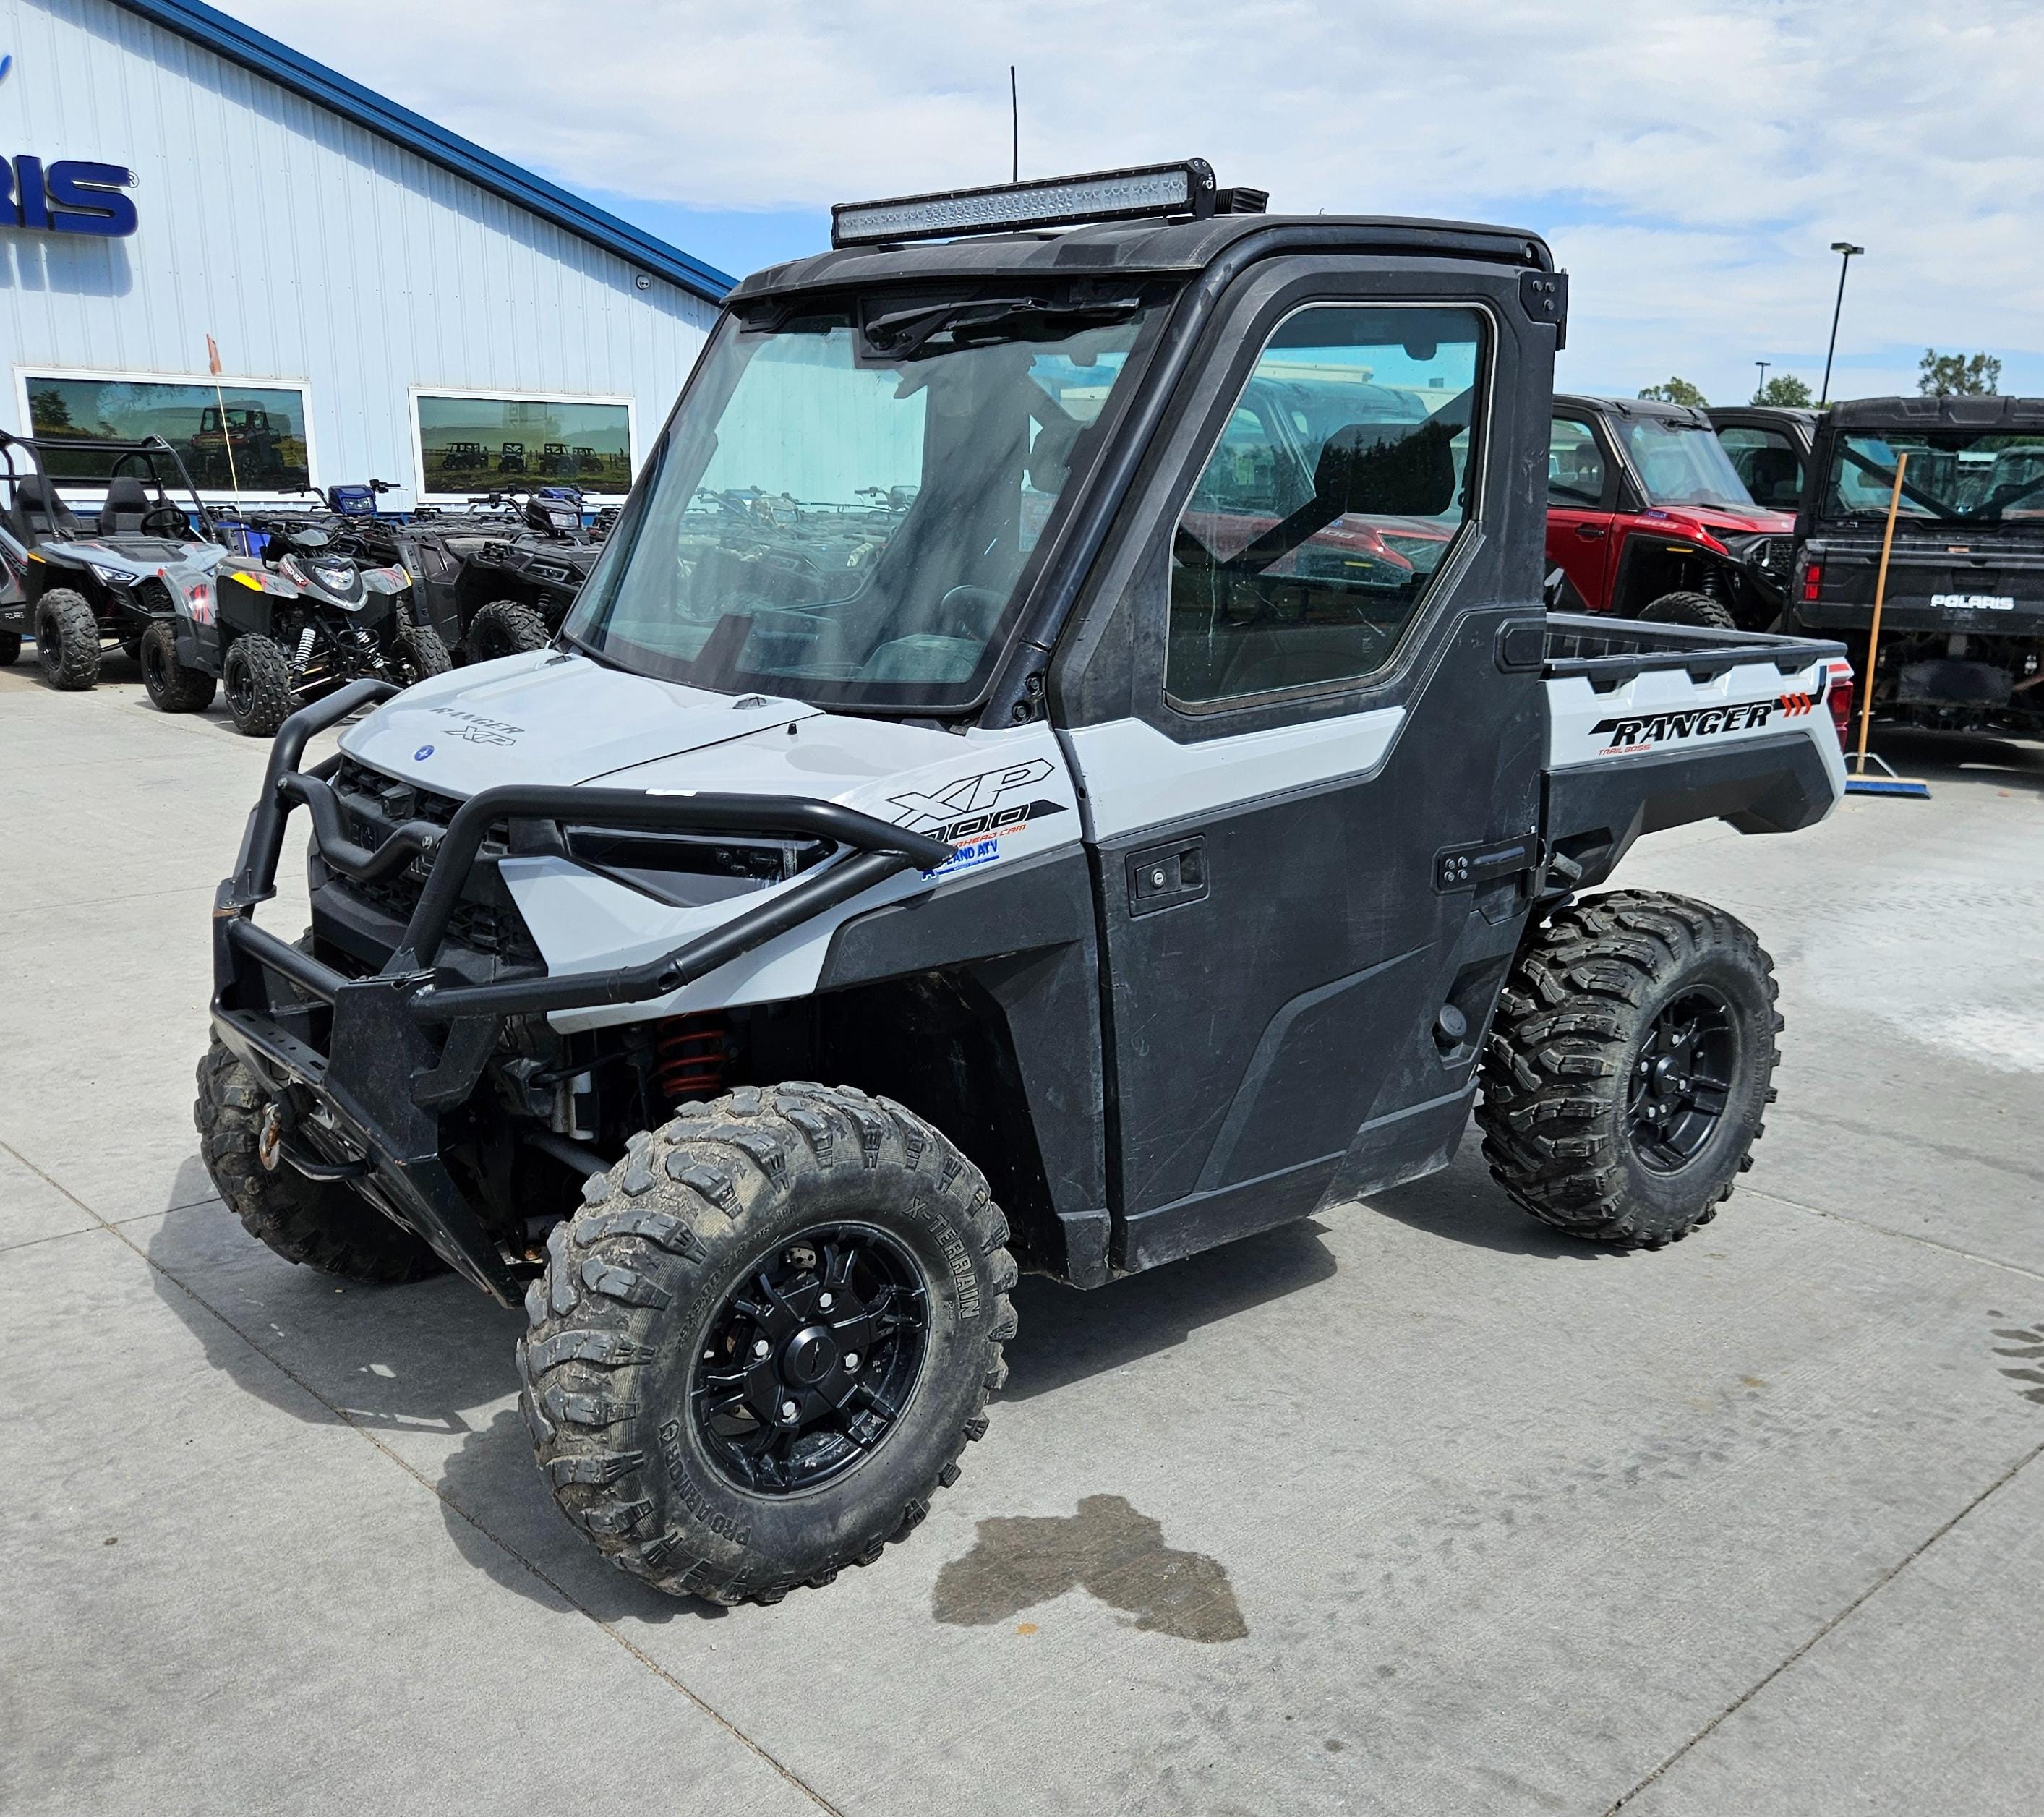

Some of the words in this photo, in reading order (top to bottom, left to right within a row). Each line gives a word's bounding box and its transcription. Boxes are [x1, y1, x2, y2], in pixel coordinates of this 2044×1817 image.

[1930, 594, 2014, 610] POLARIS
[429, 707, 525, 734] RANGER
[1609, 704, 1774, 747] RANGER
[442, 725, 516, 746] XP
[1599, 748, 1623, 756] TRAIL
[1625, 744, 1651, 753] BOSS
[884, 758, 1055, 829] XP
[1000, 824, 1027, 837] CAM
[978, 839, 999, 858] ATV
[902, 1197, 980, 1320] X-TERRAIN
